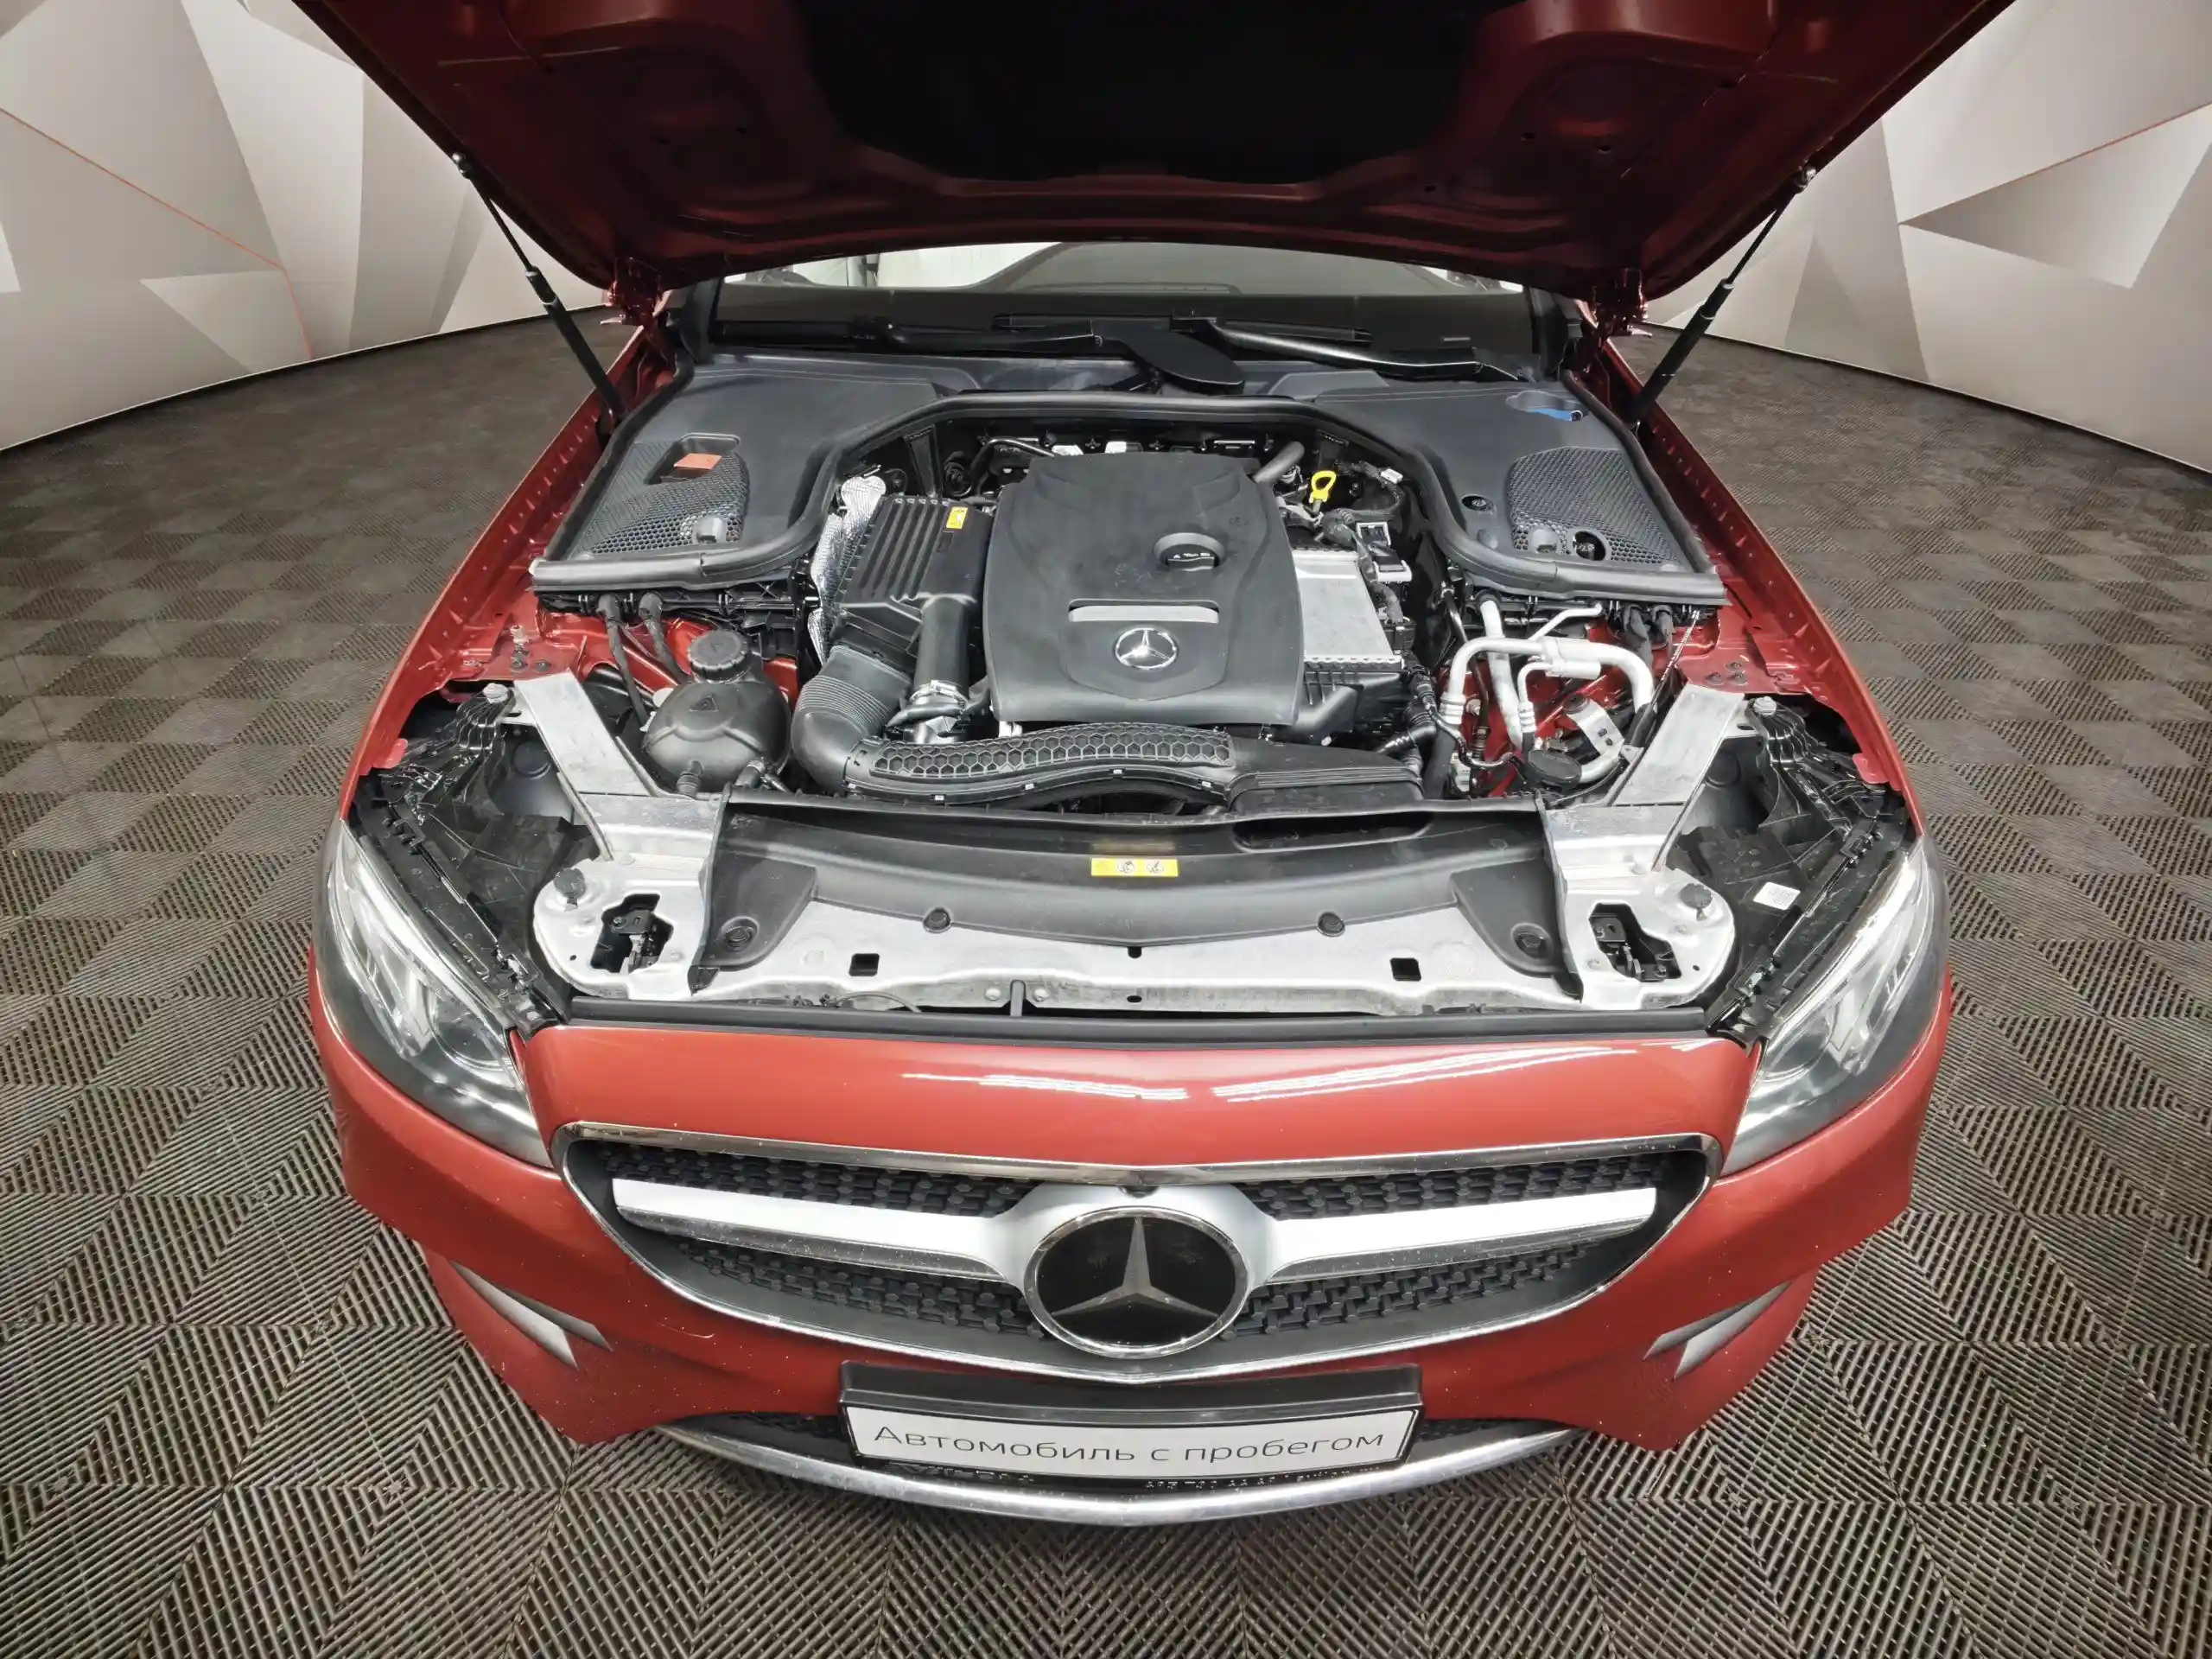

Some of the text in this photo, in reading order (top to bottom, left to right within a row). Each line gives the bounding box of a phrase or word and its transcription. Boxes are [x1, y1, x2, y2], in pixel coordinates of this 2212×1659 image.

[874, 1426, 1384, 1463] Автомобиль с пробегом
